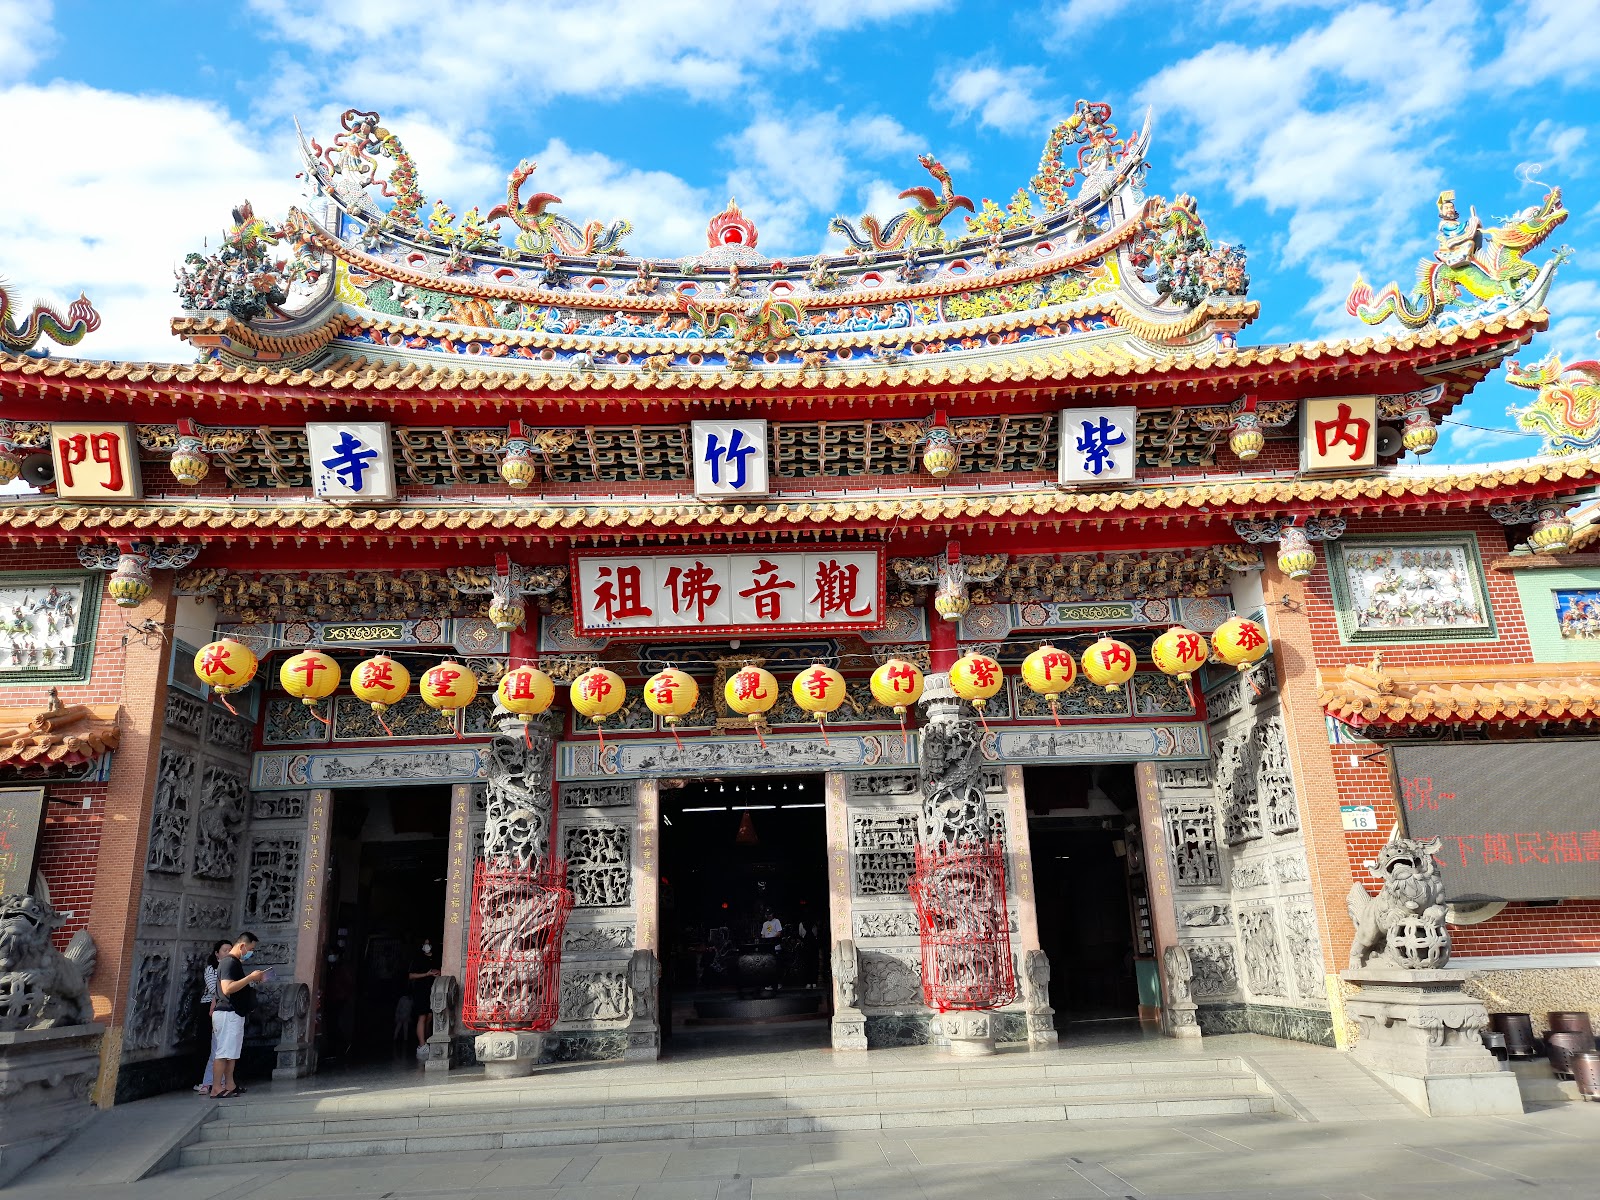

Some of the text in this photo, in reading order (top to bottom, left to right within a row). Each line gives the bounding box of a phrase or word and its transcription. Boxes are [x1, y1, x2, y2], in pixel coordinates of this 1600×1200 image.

[704, 428, 757, 490] 竹
[1076, 416, 1127, 475] 紫
[58, 431, 124, 491] 門
[321, 431, 378, 492] 寺
[1176, 632, 1205, 663] 祝
[1235, 621, 1266, 651] 恭
[201, 645, 237, 677] 秋
[293, 656, 328, 688] 千
[361, 661, 396, 691] 誕
[969, 657, 999, 688] 紫
[1042, 652, 1072, 682] 門
[428, 667, 461, 697] 聖
[503, 672, 535, 700] 祖
[579, 672, 612, 702] 佛
[649, 674, 680, 704] 音
[735, 671, 768, 701] 觀
[803, 670, 834, 700] 寺
[887, 664, 917, 694] 竹
[1352, 817, 1368, 828] 18
